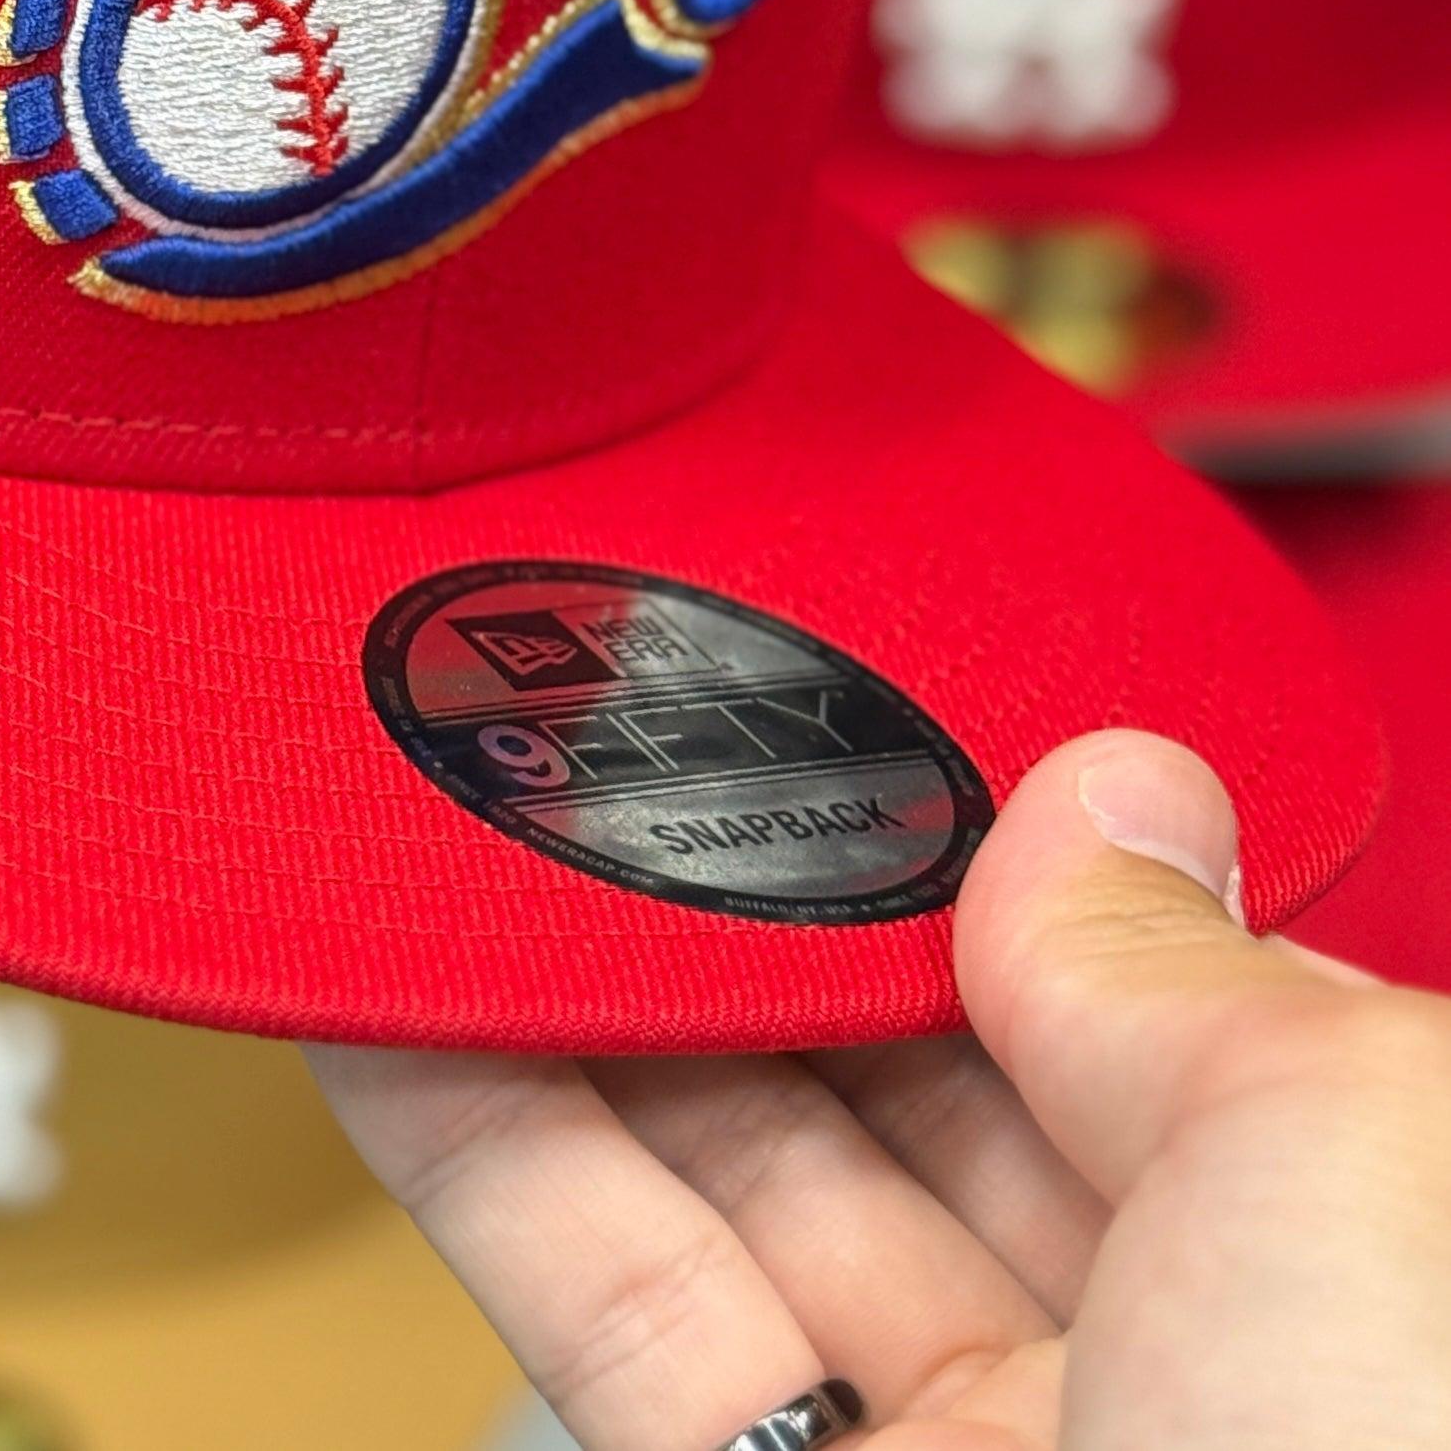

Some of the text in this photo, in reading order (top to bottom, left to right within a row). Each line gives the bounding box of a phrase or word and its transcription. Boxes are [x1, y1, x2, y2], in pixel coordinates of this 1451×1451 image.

[580, 615, 664, 643] NEW
[604, 636, 689, 662] ERA
[648, 798, 906, 855] SNAPBACK
